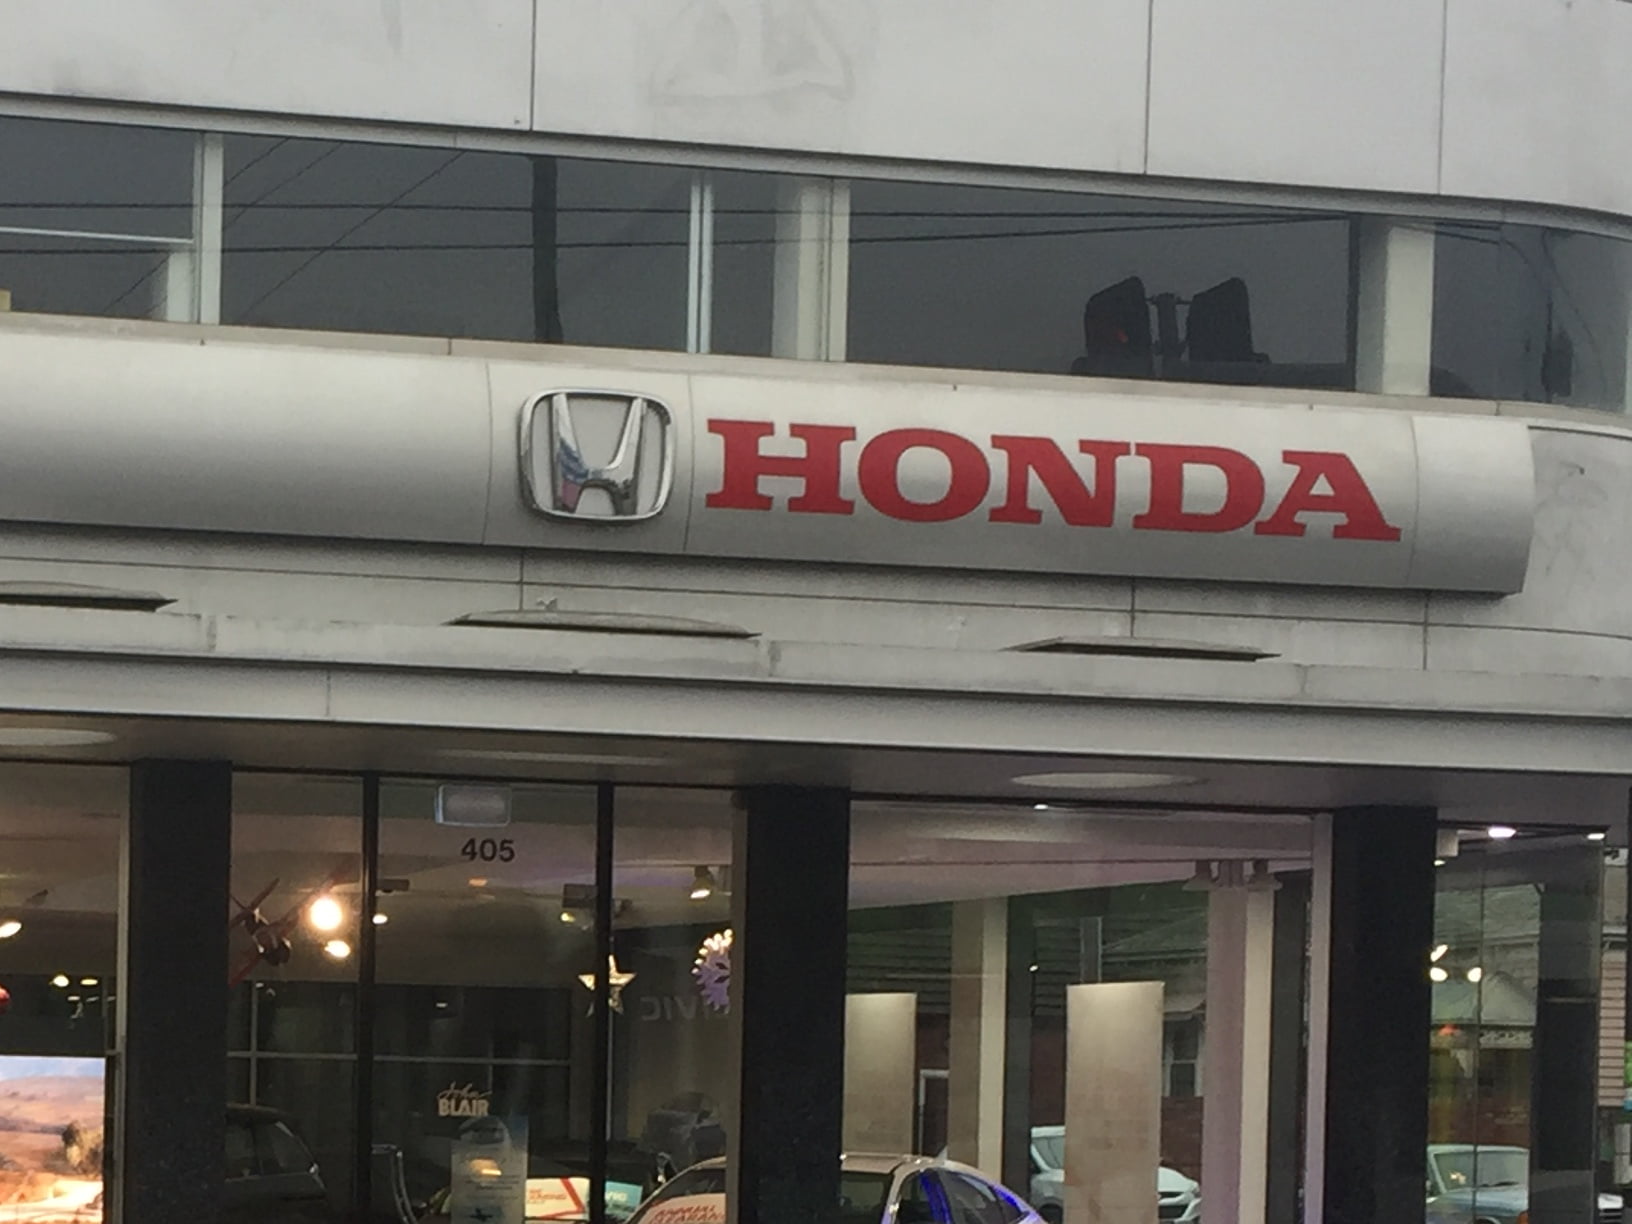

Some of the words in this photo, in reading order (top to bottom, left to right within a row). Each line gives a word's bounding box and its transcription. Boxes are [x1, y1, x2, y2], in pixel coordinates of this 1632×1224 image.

[706, 419, 1401, 541] HONDA
[461, 837, 516, 862] 405
[438, 1098, 489, 1117] BLAIR
